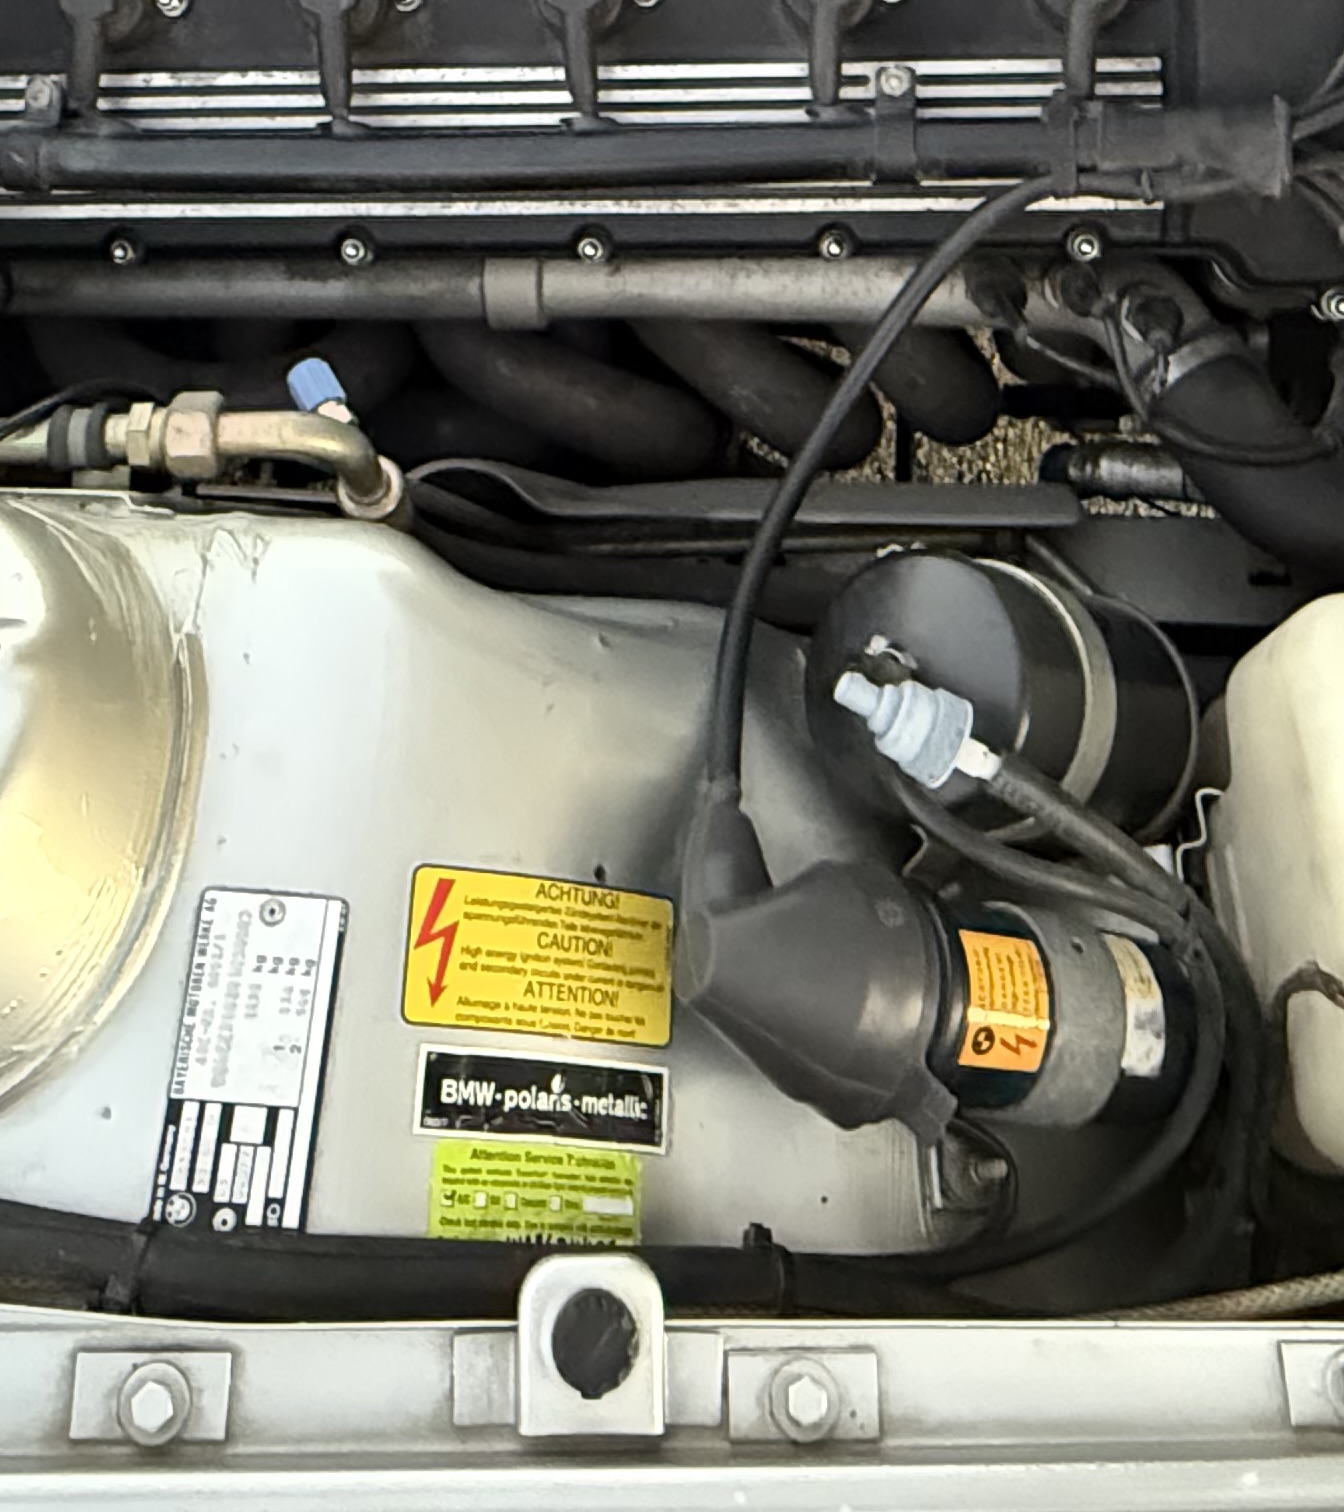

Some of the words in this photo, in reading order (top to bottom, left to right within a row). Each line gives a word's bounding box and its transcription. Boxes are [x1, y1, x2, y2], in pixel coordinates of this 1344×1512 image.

[203, 897, 217, 912] AG
[535, 882, 620, 909] ACHTUNG!
[537, 931, 613, 957] CAUTION!
[522, 980, 619, 1007] ATTENTION!
